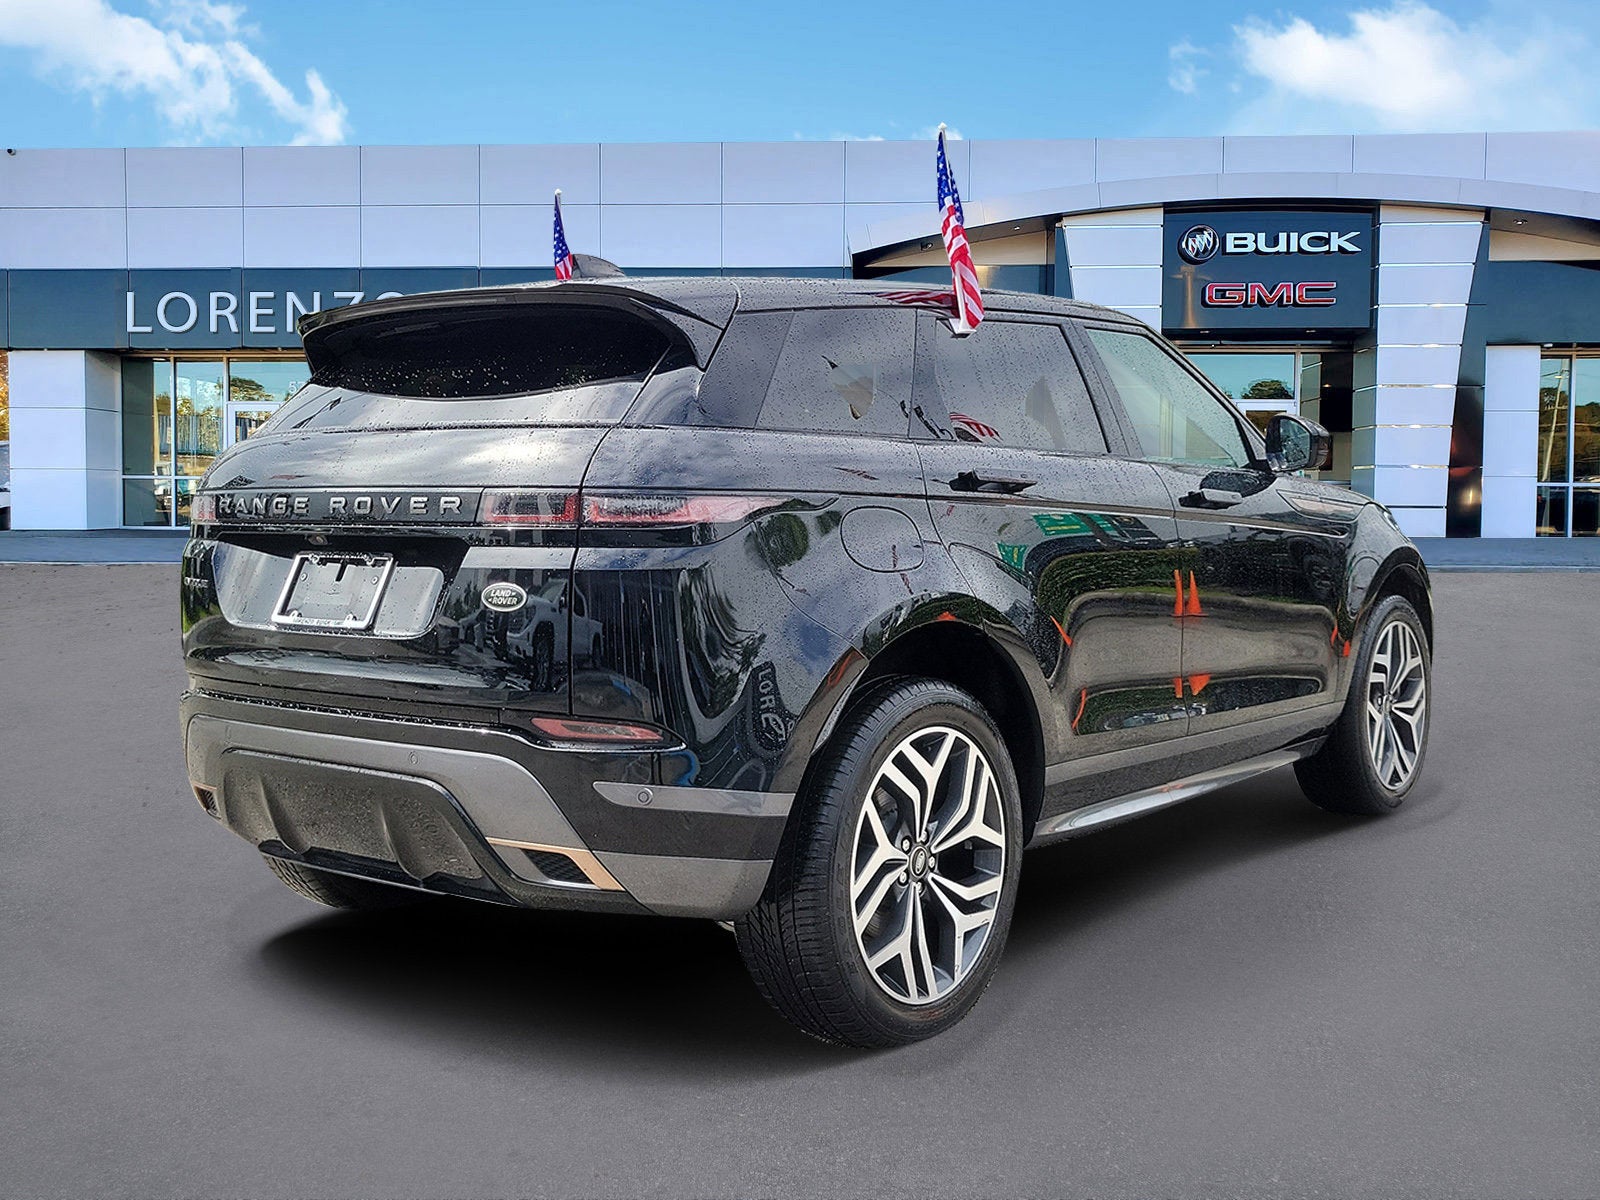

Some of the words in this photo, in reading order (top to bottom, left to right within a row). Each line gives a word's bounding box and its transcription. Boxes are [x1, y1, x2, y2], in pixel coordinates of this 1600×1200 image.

[1225, 231, 1362, 253] BUICK
[1205, 282, 1337, 305] GMC
[125, 291, 404, 334] LOREN
[219, 496, 311, 515] RANGE
[328, 496, 462, 515] ROVER
[490, 589, 512, 597] LAND
[491, 596, 518, 605] ROVER
